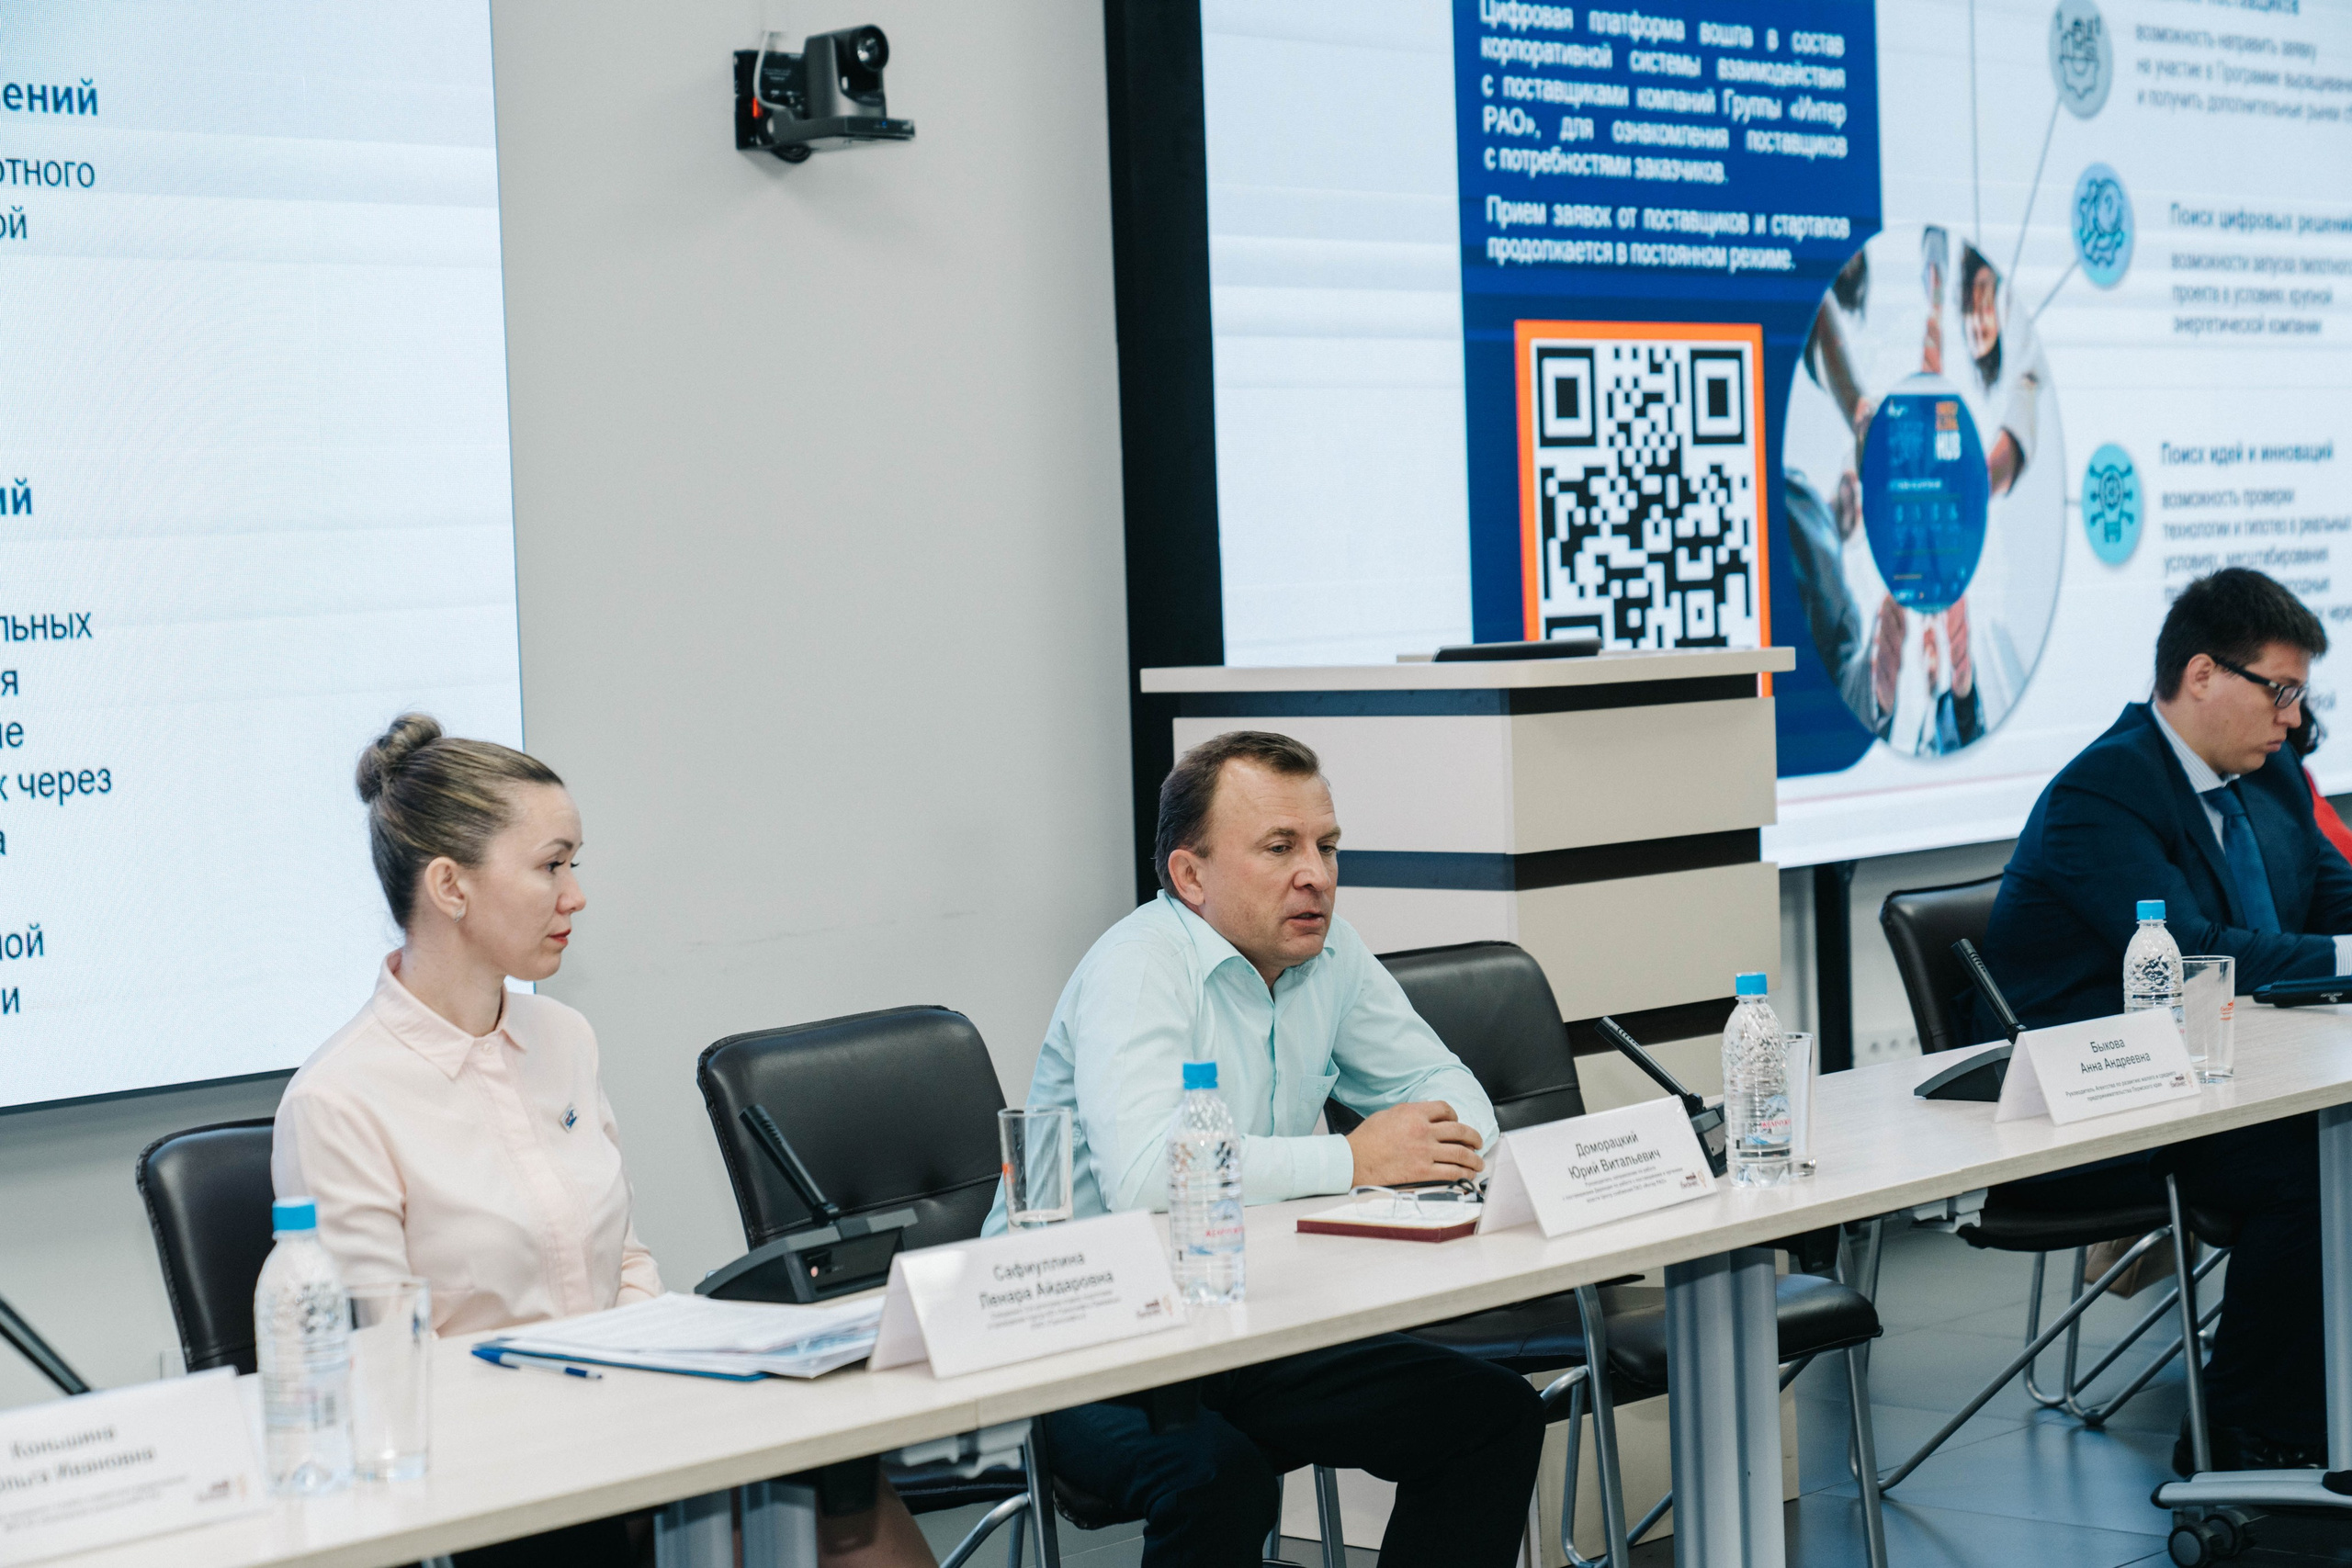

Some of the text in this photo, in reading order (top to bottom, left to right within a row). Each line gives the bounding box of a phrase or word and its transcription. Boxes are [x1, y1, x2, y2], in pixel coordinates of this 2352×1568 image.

[1480, 0, 1846, 59] Цифровая платформа вошла в состав
[1480, 35, 1846, 90] корпоративной системы взаимодействия
[3, 77, 98, 117] ений
[1481, 73, 1495, 97] с
[1502, 75, 1629, 109] поставщиками
[1635, 86, 1716, 116] компаний
[1721, 87, 1782, 124] Группы
[1560, 116, 1594, 142] для
[1611, 118, 1730, 150] ознакомления
[1746, 128, 1848, 162] поставщиков
[1484, 145, 1729, 184] с потребностями заказчиков.
[1486, 194, 1850, 244] Прием заявок от поставщиков и стартапов
[1487, 236, 1613, 267] продолжается
[1616, 242, 1628, 265] в
[1630, 243, 1727, 271] постоянном
[0, 721, 24, 750] е
[17, 768, 112, 807] через
[0, 922, 45, 961] ой
[2080, 1052, 2151, 1074] Анна Андреевна
[2090, 1039, 2125, 1053] Быкова
[1576, 1131, 1639, 1158] Доморацкий
[1568, 1149, 1661, 1180] Юрий Витальевич
[993, 1252, 1085, 1281] Сафиуллина
[979, 1271, 1114, 1309] Ленара Айдаровна
